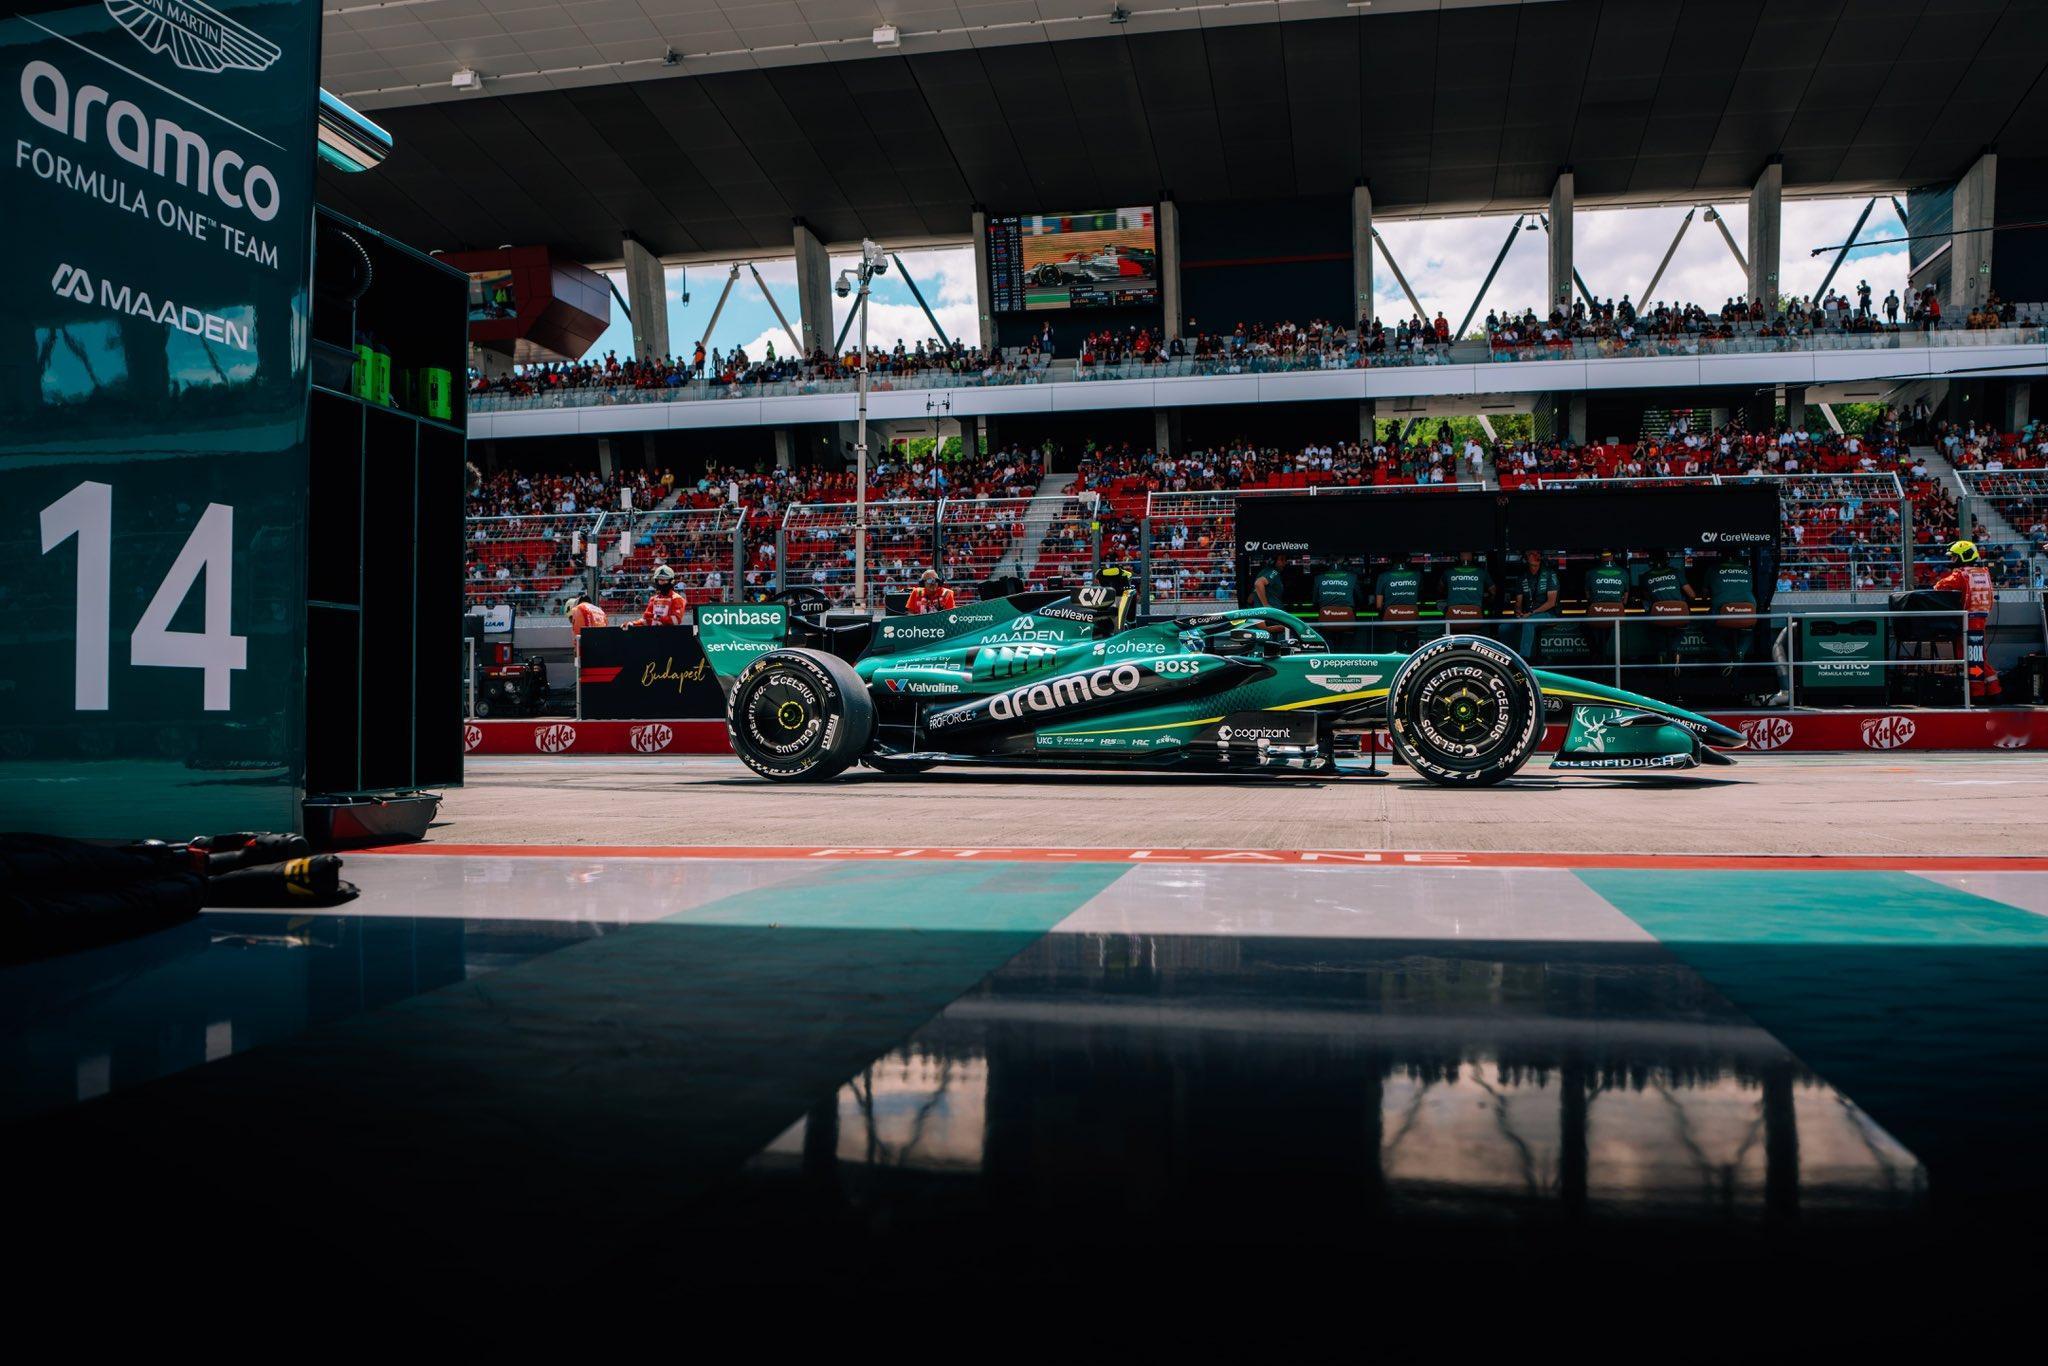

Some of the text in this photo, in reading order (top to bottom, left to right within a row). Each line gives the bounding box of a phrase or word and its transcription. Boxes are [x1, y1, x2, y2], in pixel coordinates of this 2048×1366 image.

[166, 2, 219, 43] MARTIN
[20, 60, 280, 222] aramco
[16, 140, 149, 219] FORMULA
[221, 223, 279, 270] TEAM
[101, 279, 249, 350] MAADEN
[1720, 532, 1771, 542] CoreWeave
[1262, 541, 1309, 551] CoreWeave
[1648, 574, 1676, 585] aramco
[40, 480, 247, 711] 14
[801, 602, 823, 612] arm
[1039, 607, 1094, 622] CoreWeave
[702, 609, 781, 625] coinbase
[959, 614, 993, 623] cognizant
[897, 626, 945, 638] cohere
[981, 630, 1064, 644] MAADEN
[707, 640, 778, 652] servicenow
[1107, 640, 1165, 654] cohere
[1470, 641, 1512, 666] PIRELLI
[1155, 660, 1199, 674] BOSS
[1323, 658, 1378, 667] pepperstone
[641, 657, 711, 692] Budapest
[780, 676, 816, 705] CELSIUS
[988, 664, 1140, 720] aramco
[1490, 690, 1509, 740] CELSIUS
[1234, 727, 1290, 740] cognizant
[1421, 719, 1463, 754] CELSIUS
[1747, 718, 1791, 749] KitKat
[1868, 717, 1913, 748] KitKat
[776, 729, 814, 754] CELSIUS
[1036, 737, 1053, 745] UKG
[1404, 744, 1462, 780] ZERO
[1556, 756, 1674, 768] GLENFIDDICH
[808, 849, 1013, 857] PIT
[1128, 850, 1471, 863] LANE
